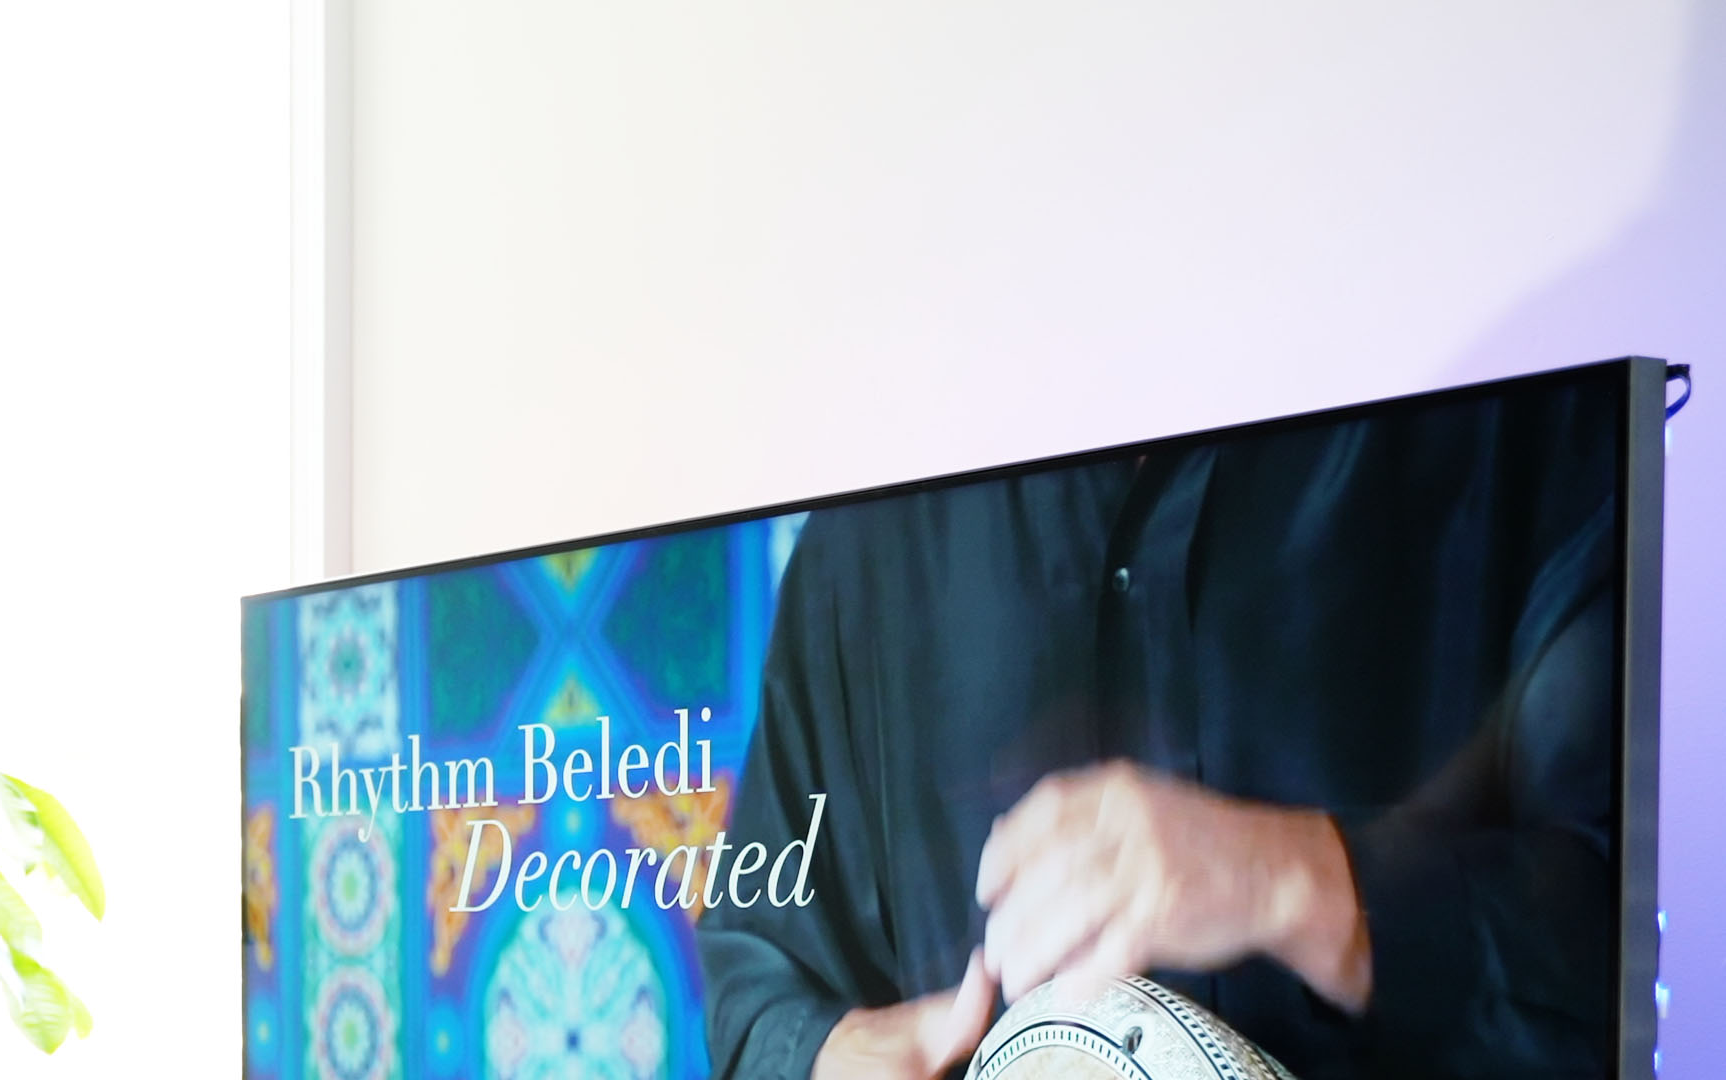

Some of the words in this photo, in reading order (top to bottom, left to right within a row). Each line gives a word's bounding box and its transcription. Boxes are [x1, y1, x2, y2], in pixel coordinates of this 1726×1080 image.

[288, 735, 498, 842] Rhythm
[518, 707, 715, 805] Beledi
[449, 793, 827, 912] Decorated
